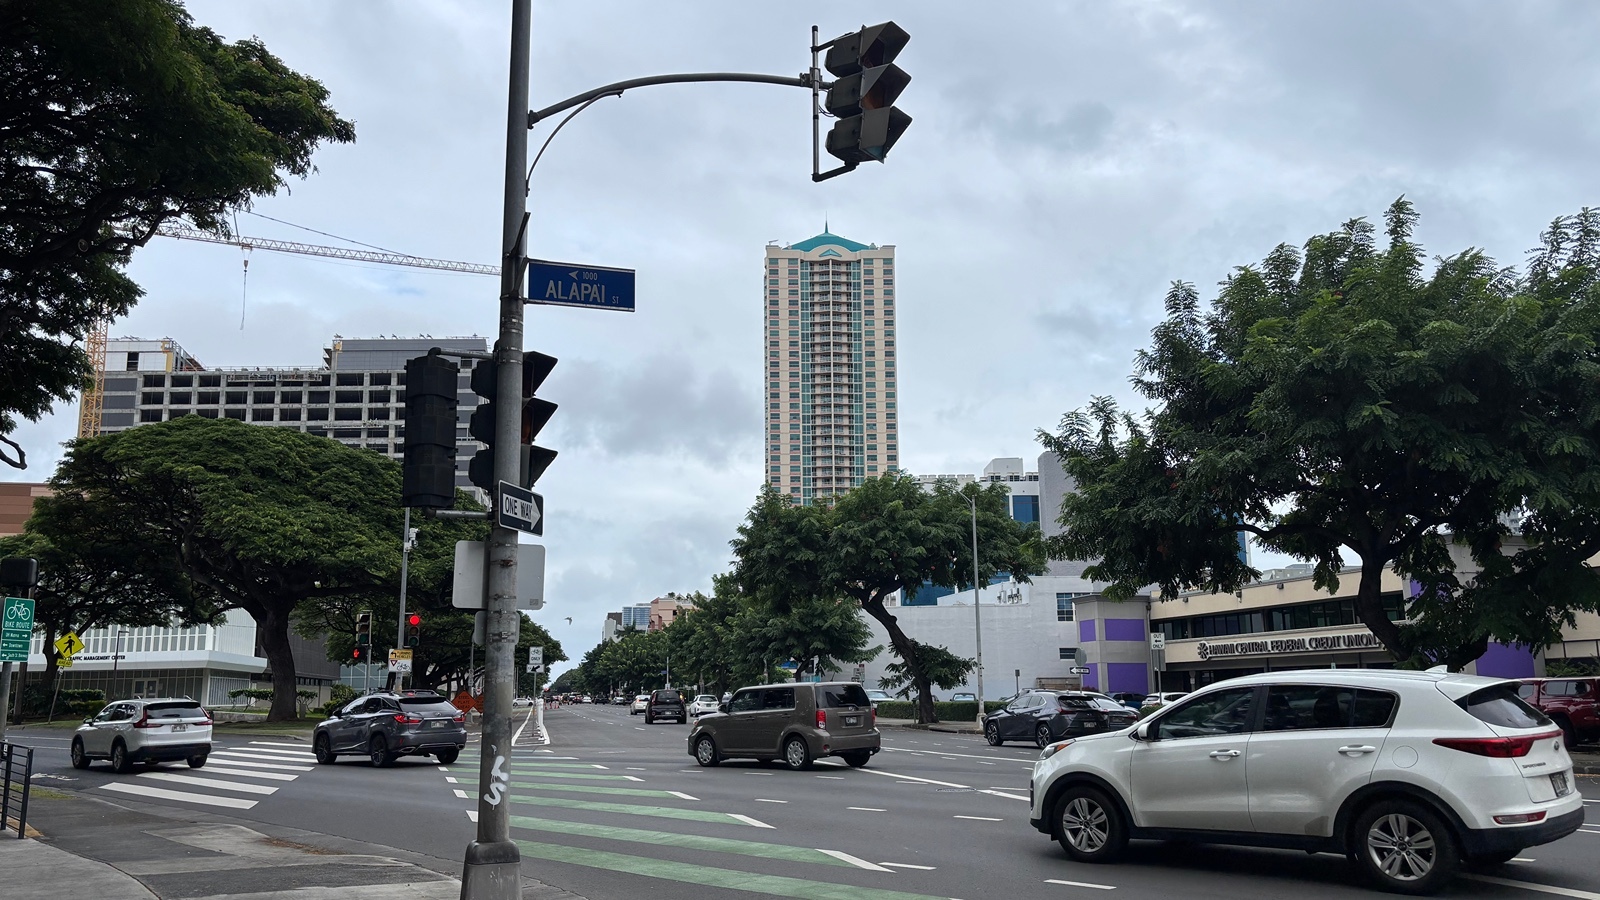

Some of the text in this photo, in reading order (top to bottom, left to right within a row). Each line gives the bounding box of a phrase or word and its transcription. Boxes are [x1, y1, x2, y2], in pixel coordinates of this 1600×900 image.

[582, 271, 598, 281] 1000
[611, 295, 619, 304] ST
[505, 496, 532, 520] ONE WAY
[1208, 633, 1377, 656] HAWAII CENTRAL FEDERAL CREDIT UNION
